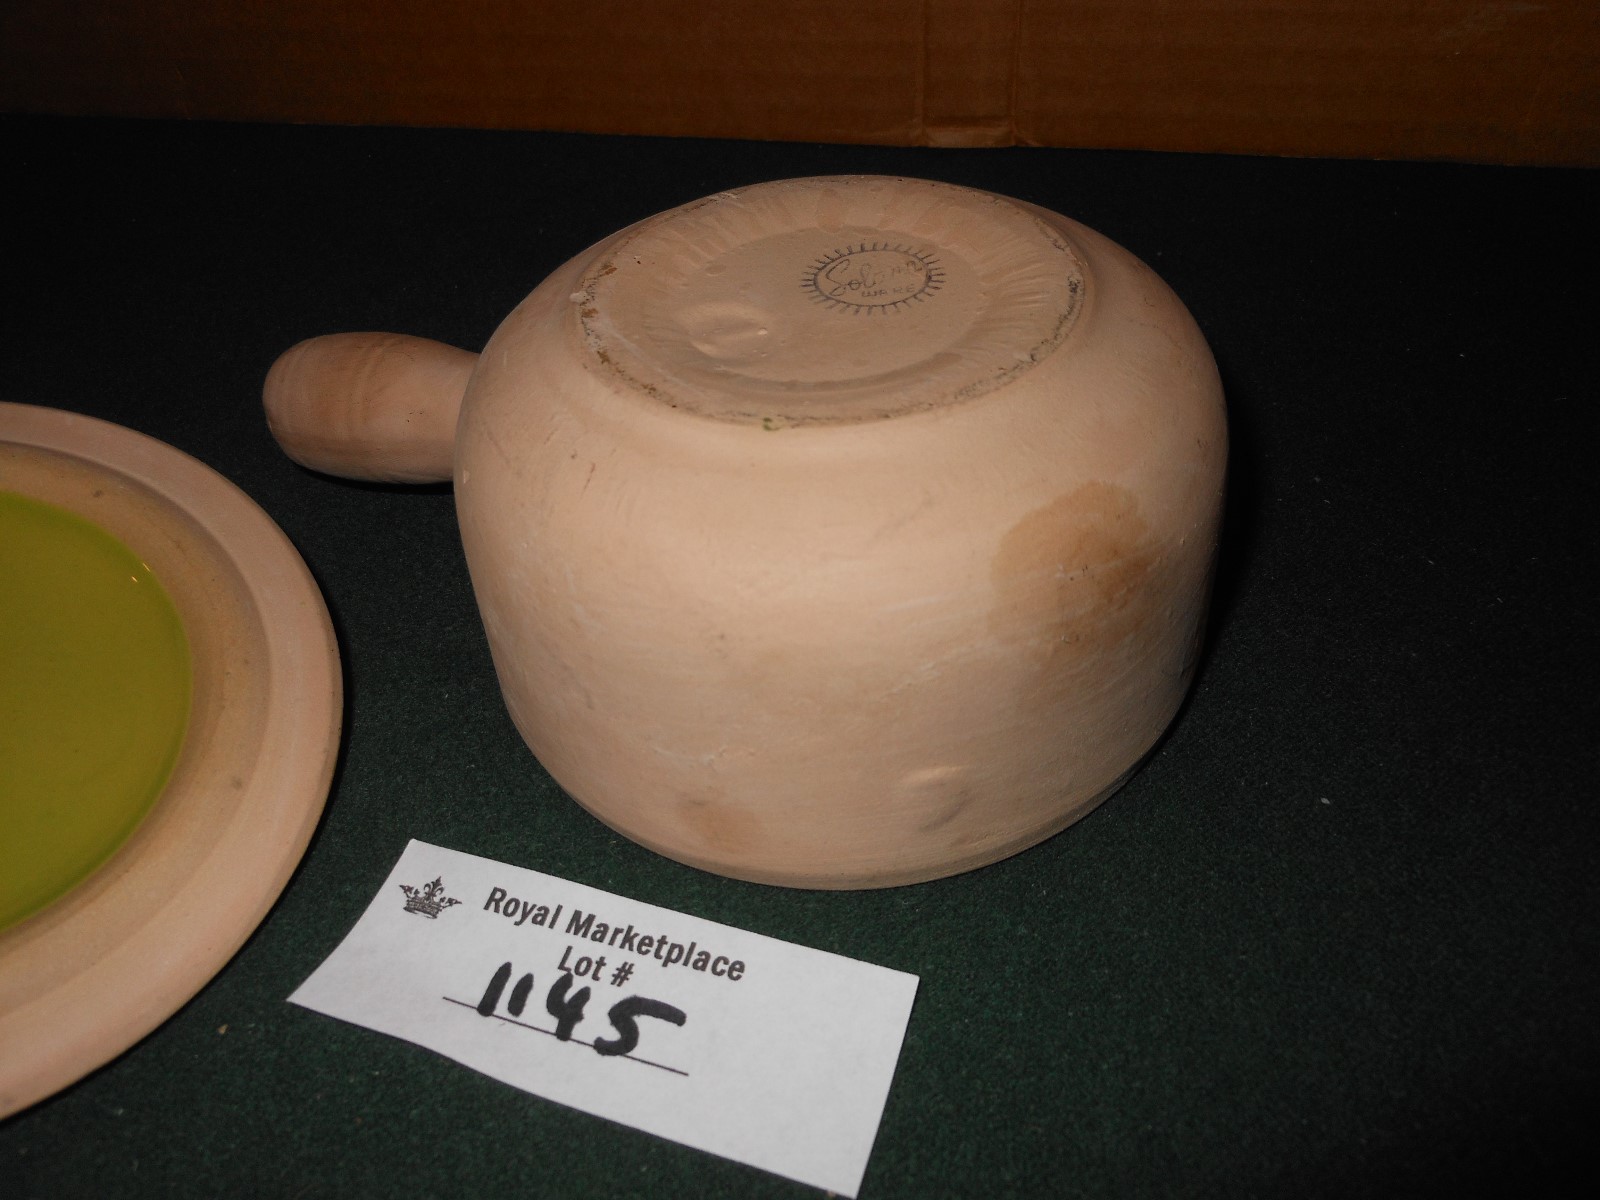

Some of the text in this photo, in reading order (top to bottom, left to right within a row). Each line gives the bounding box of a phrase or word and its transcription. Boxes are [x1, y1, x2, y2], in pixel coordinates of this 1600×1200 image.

[483, 886, 746, 981] Royal Marketplace
[557, 945, 634, 987] Lot #
[477, 961, 687, 1056] 1145
